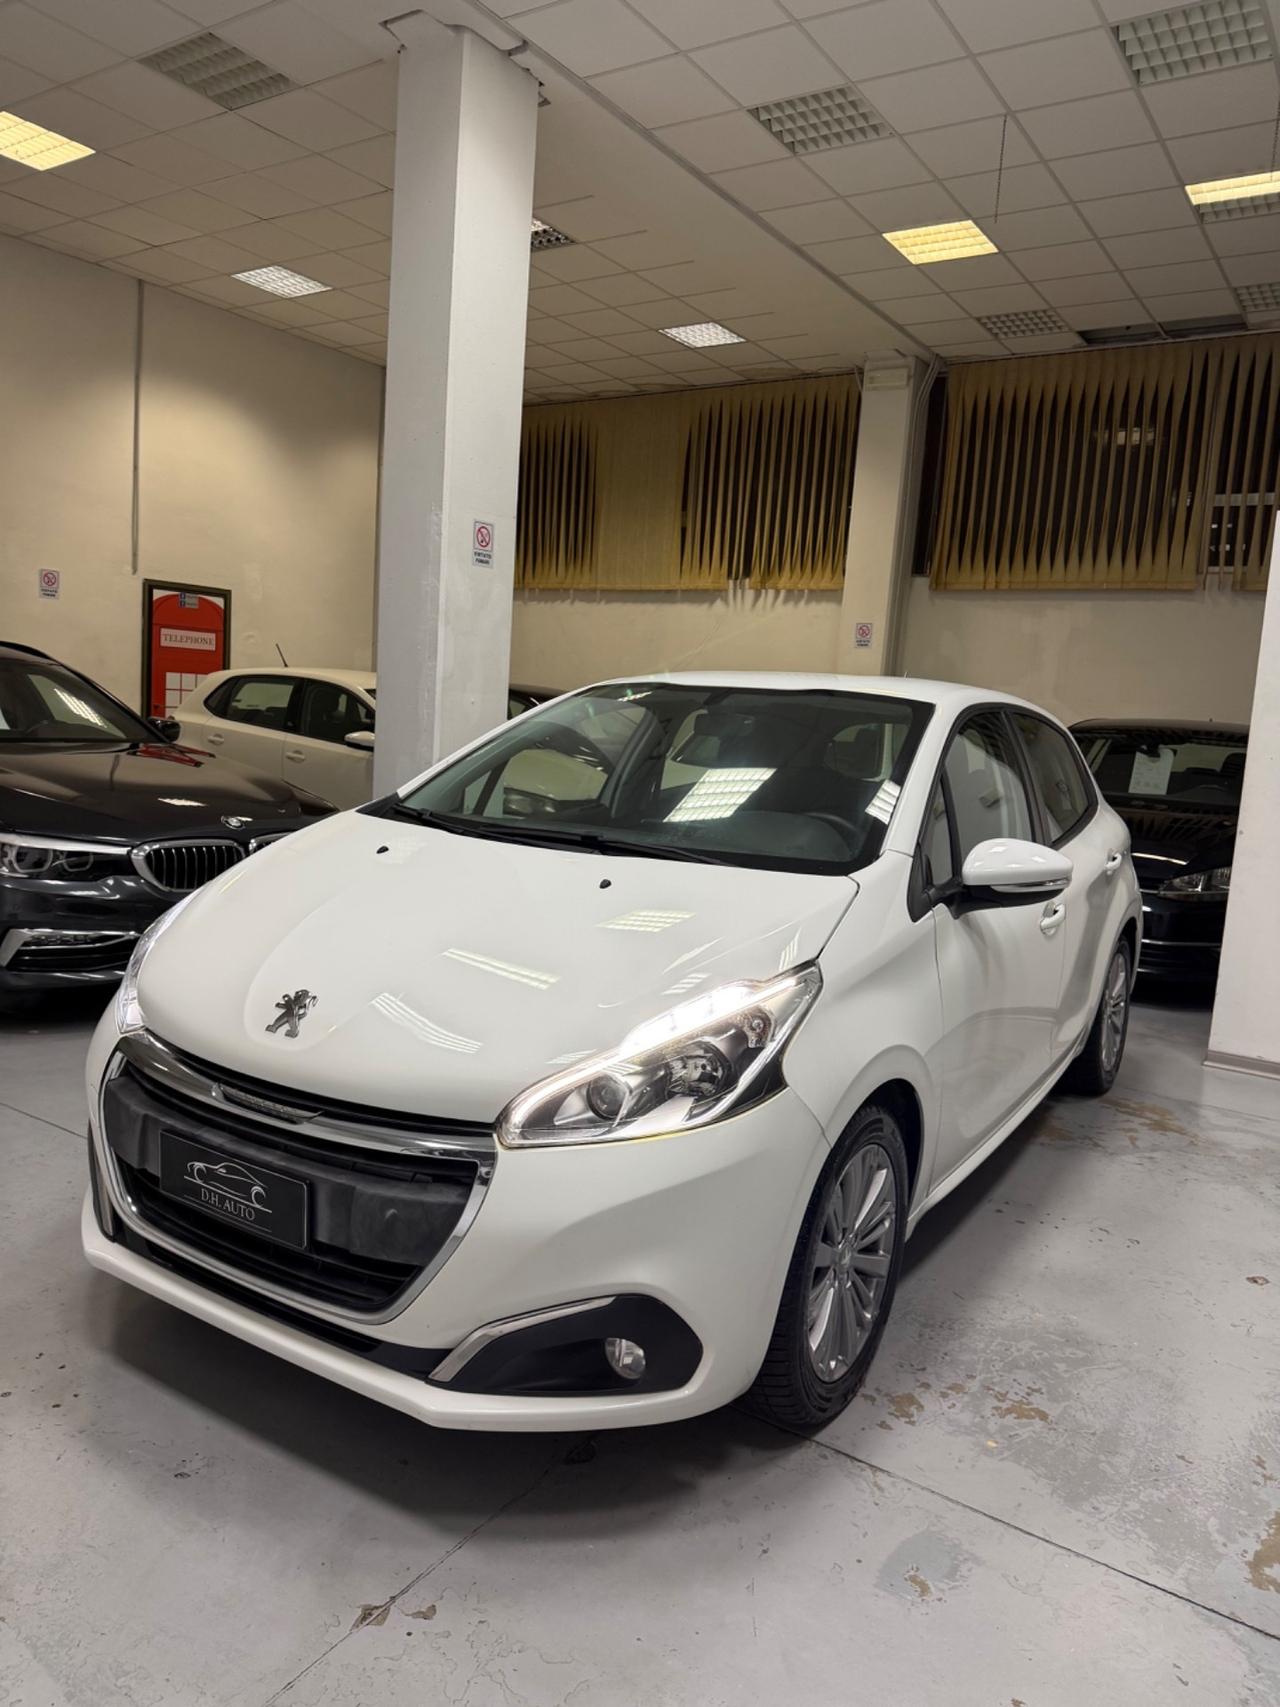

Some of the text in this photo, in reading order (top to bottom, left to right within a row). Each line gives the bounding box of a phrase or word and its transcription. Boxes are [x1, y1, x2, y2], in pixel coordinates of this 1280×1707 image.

[163, 633, 213, 646] TELEPHONE
[201, 1188, 256, 1221] D.H. AUTO
